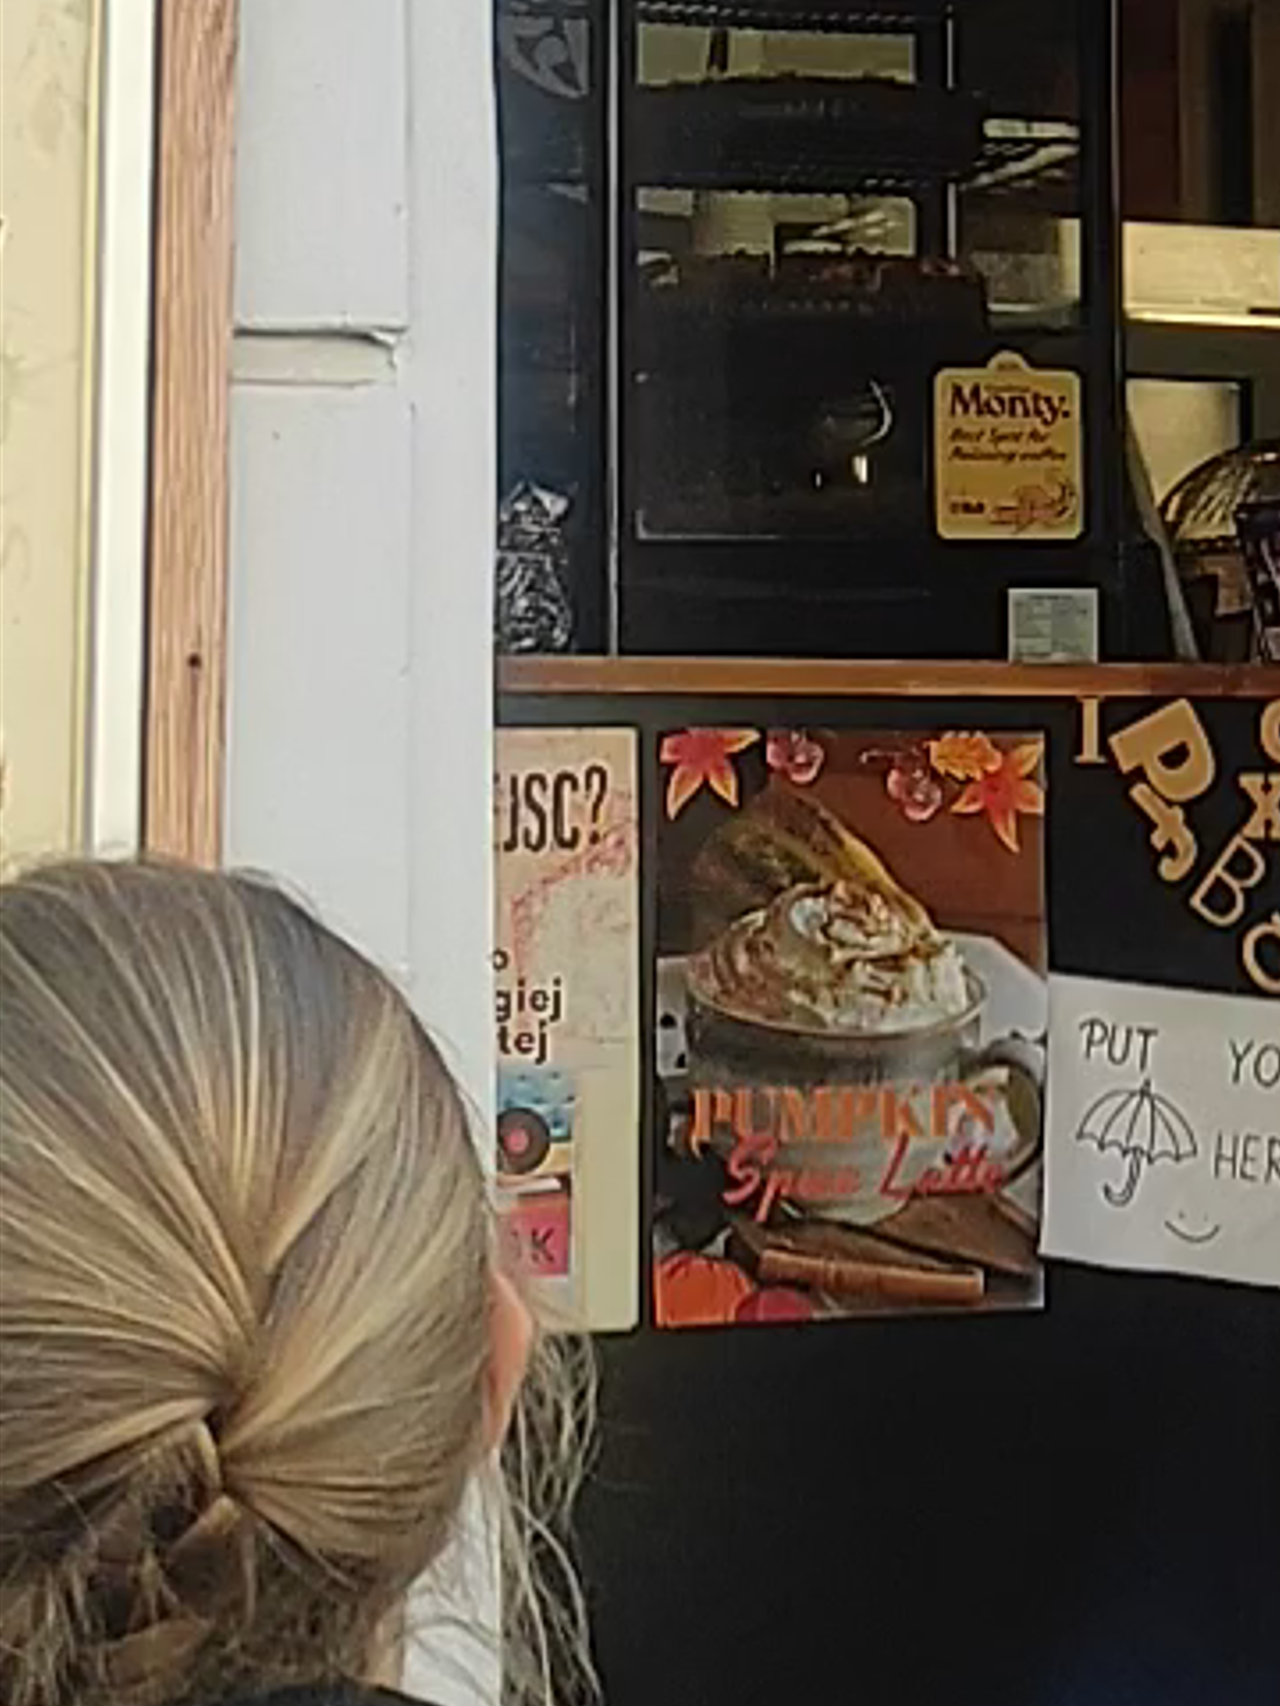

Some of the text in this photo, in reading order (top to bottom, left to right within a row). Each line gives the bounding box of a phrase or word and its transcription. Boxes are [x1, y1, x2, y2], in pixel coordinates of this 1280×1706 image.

[950, 382, 1070, 426] Monty.
[1077, 1017, 1157, 1073] PUT
[690, 1084, 996, 1159] PUMPKIN
